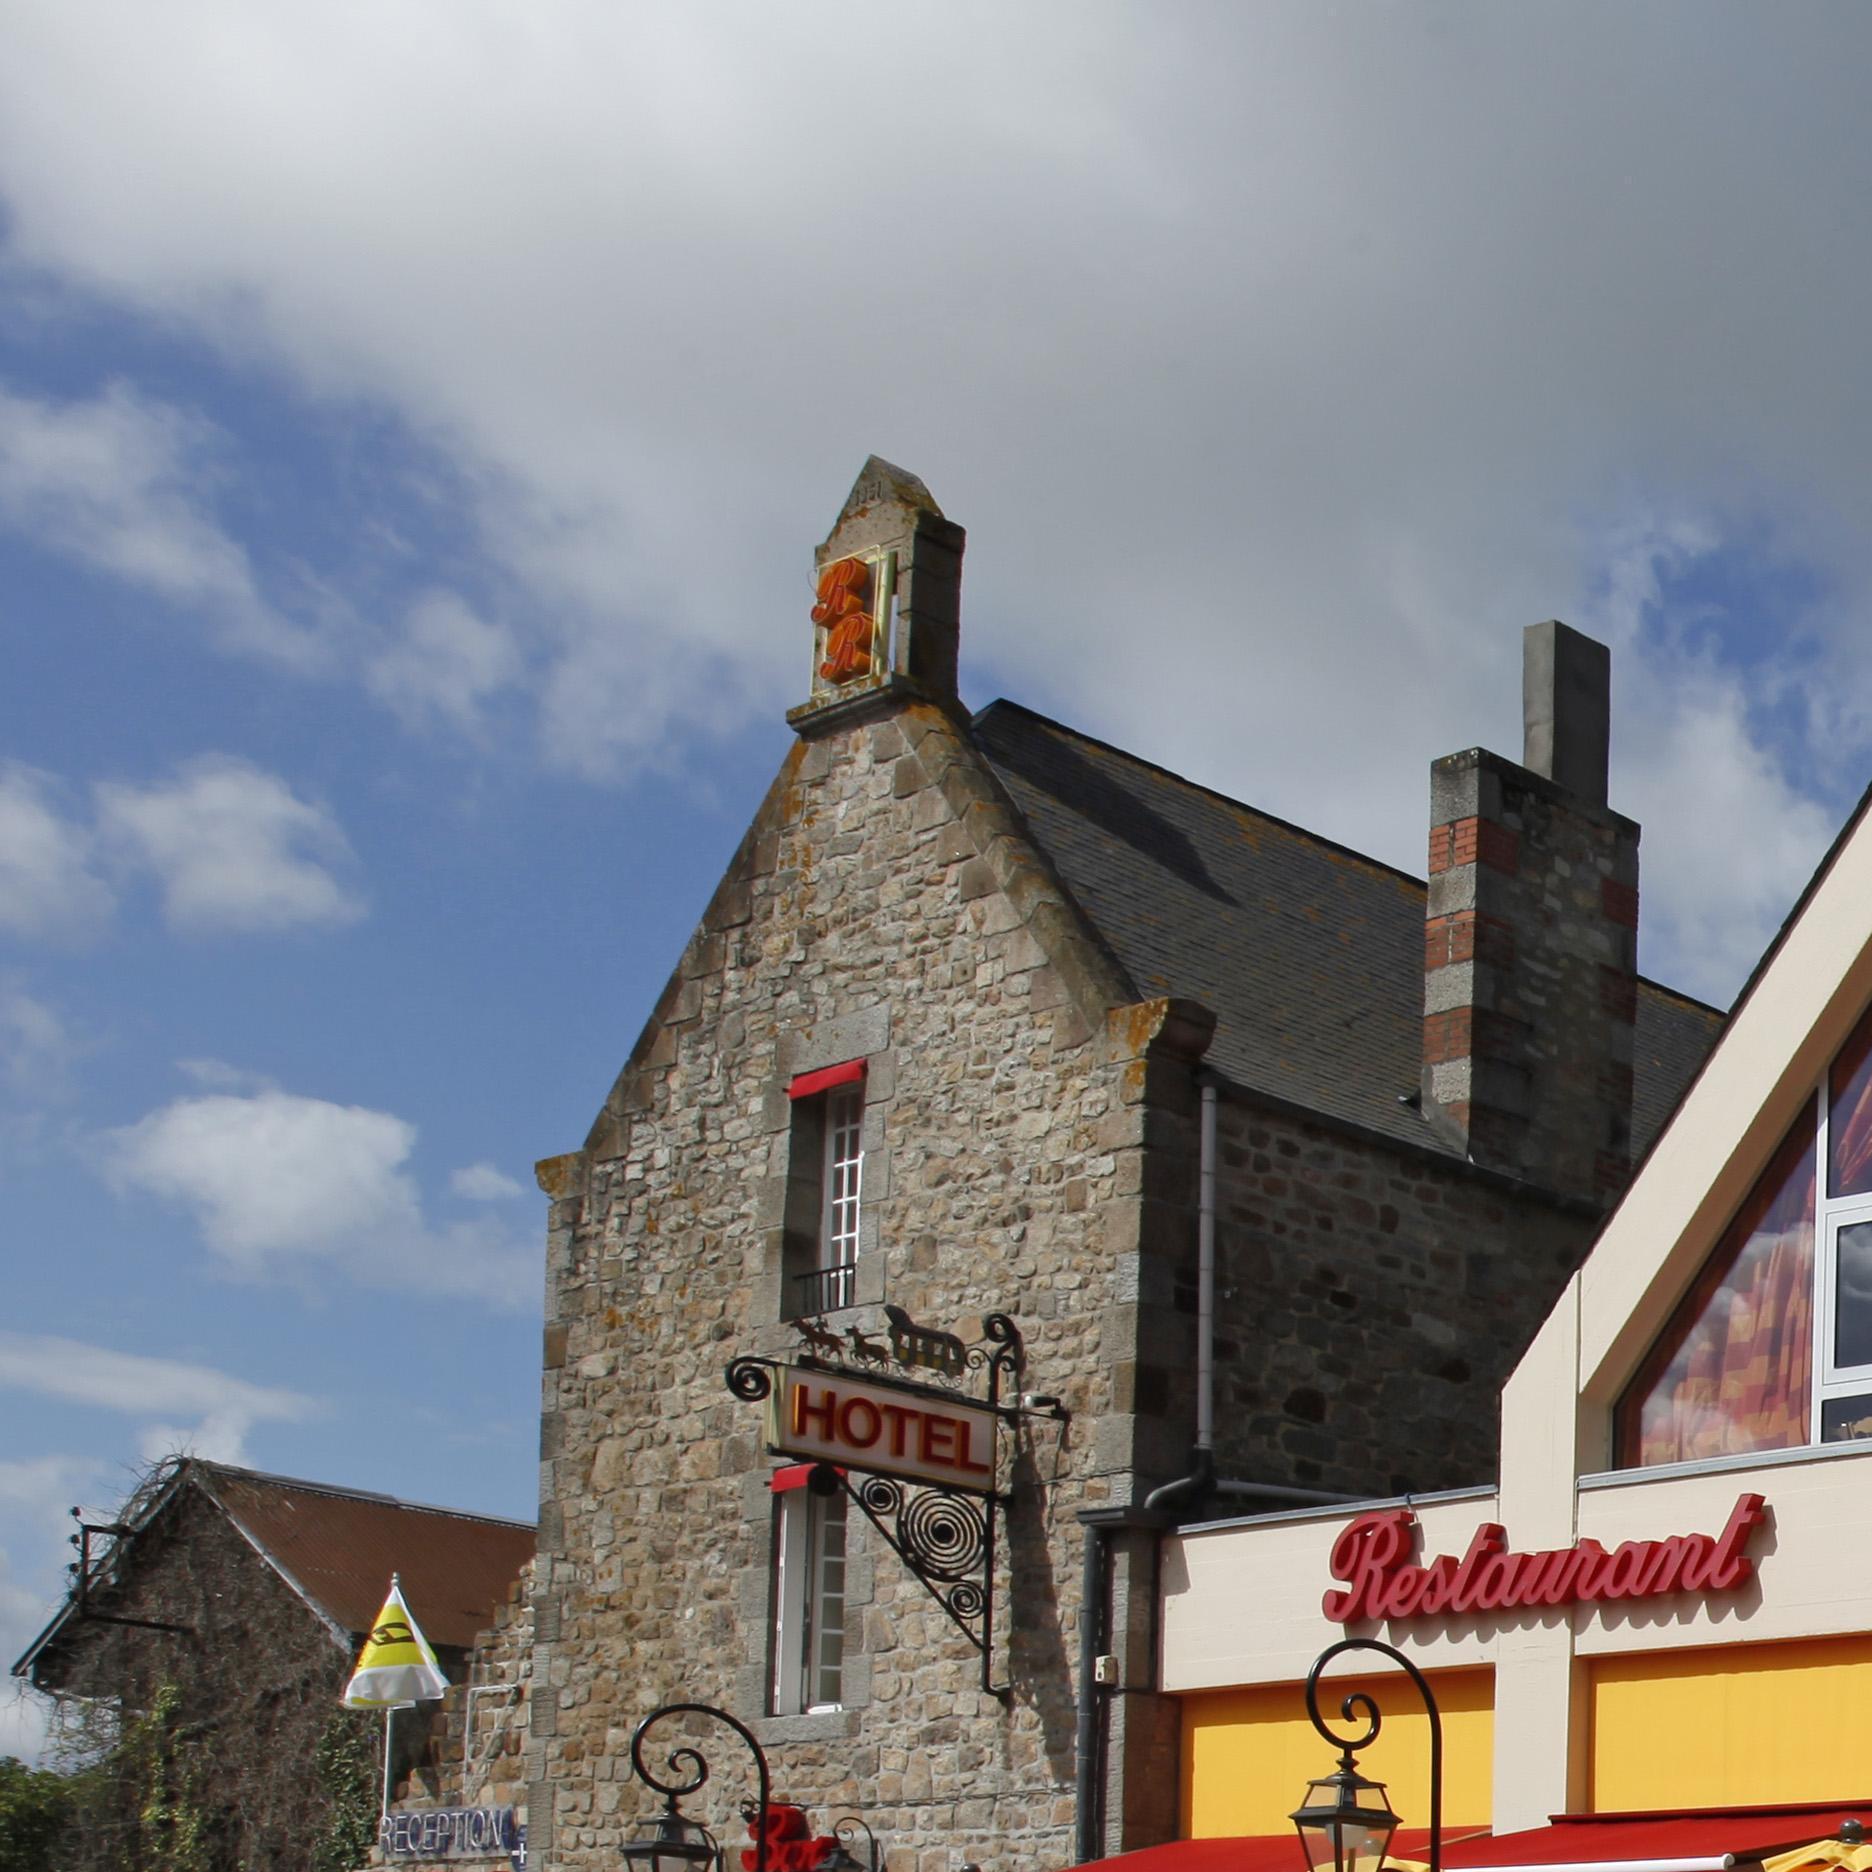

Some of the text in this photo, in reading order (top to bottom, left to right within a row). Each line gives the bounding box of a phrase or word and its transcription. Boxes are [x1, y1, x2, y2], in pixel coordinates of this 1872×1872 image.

[791, 1382, 990, 1474] HOTEL
[1323, 1492, 1768, 1624] Restaurant
[378, 1810, 504, 1853] RECEPTION
